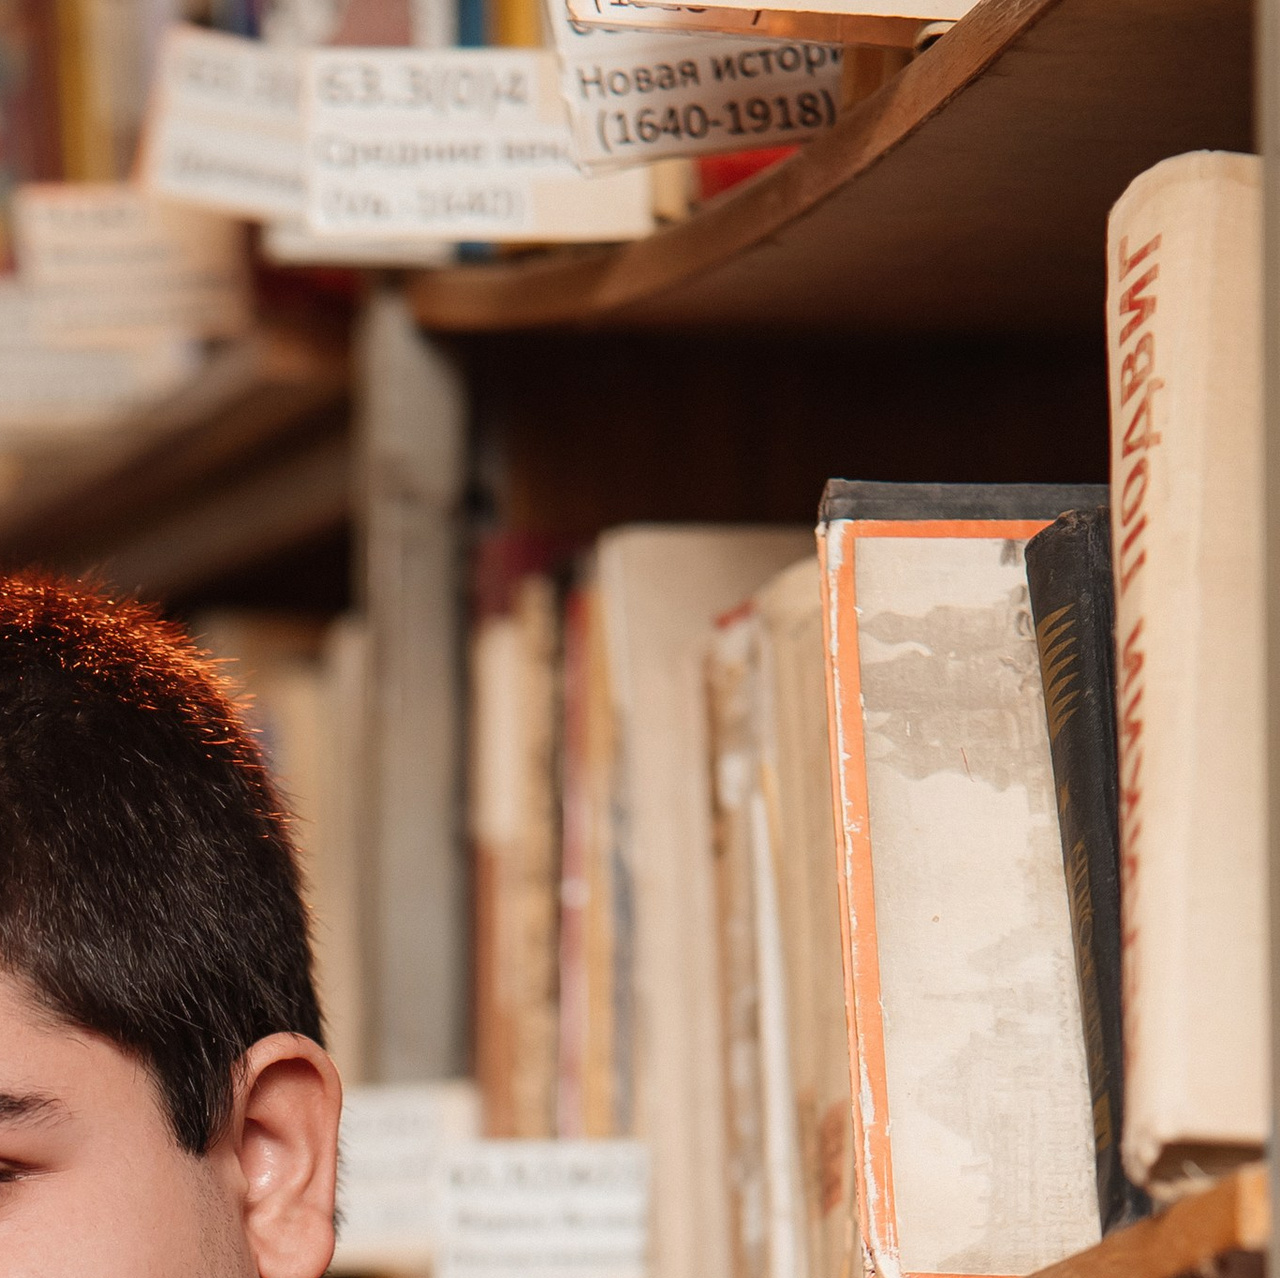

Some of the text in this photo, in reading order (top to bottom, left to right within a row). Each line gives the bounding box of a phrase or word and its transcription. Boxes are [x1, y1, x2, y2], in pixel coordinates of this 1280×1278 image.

[578, 59, 701, 98] Новая
[597, 88, 837, 153] (1640-1918)
[1119, 231, 1166, 598] ПОДВИГ
